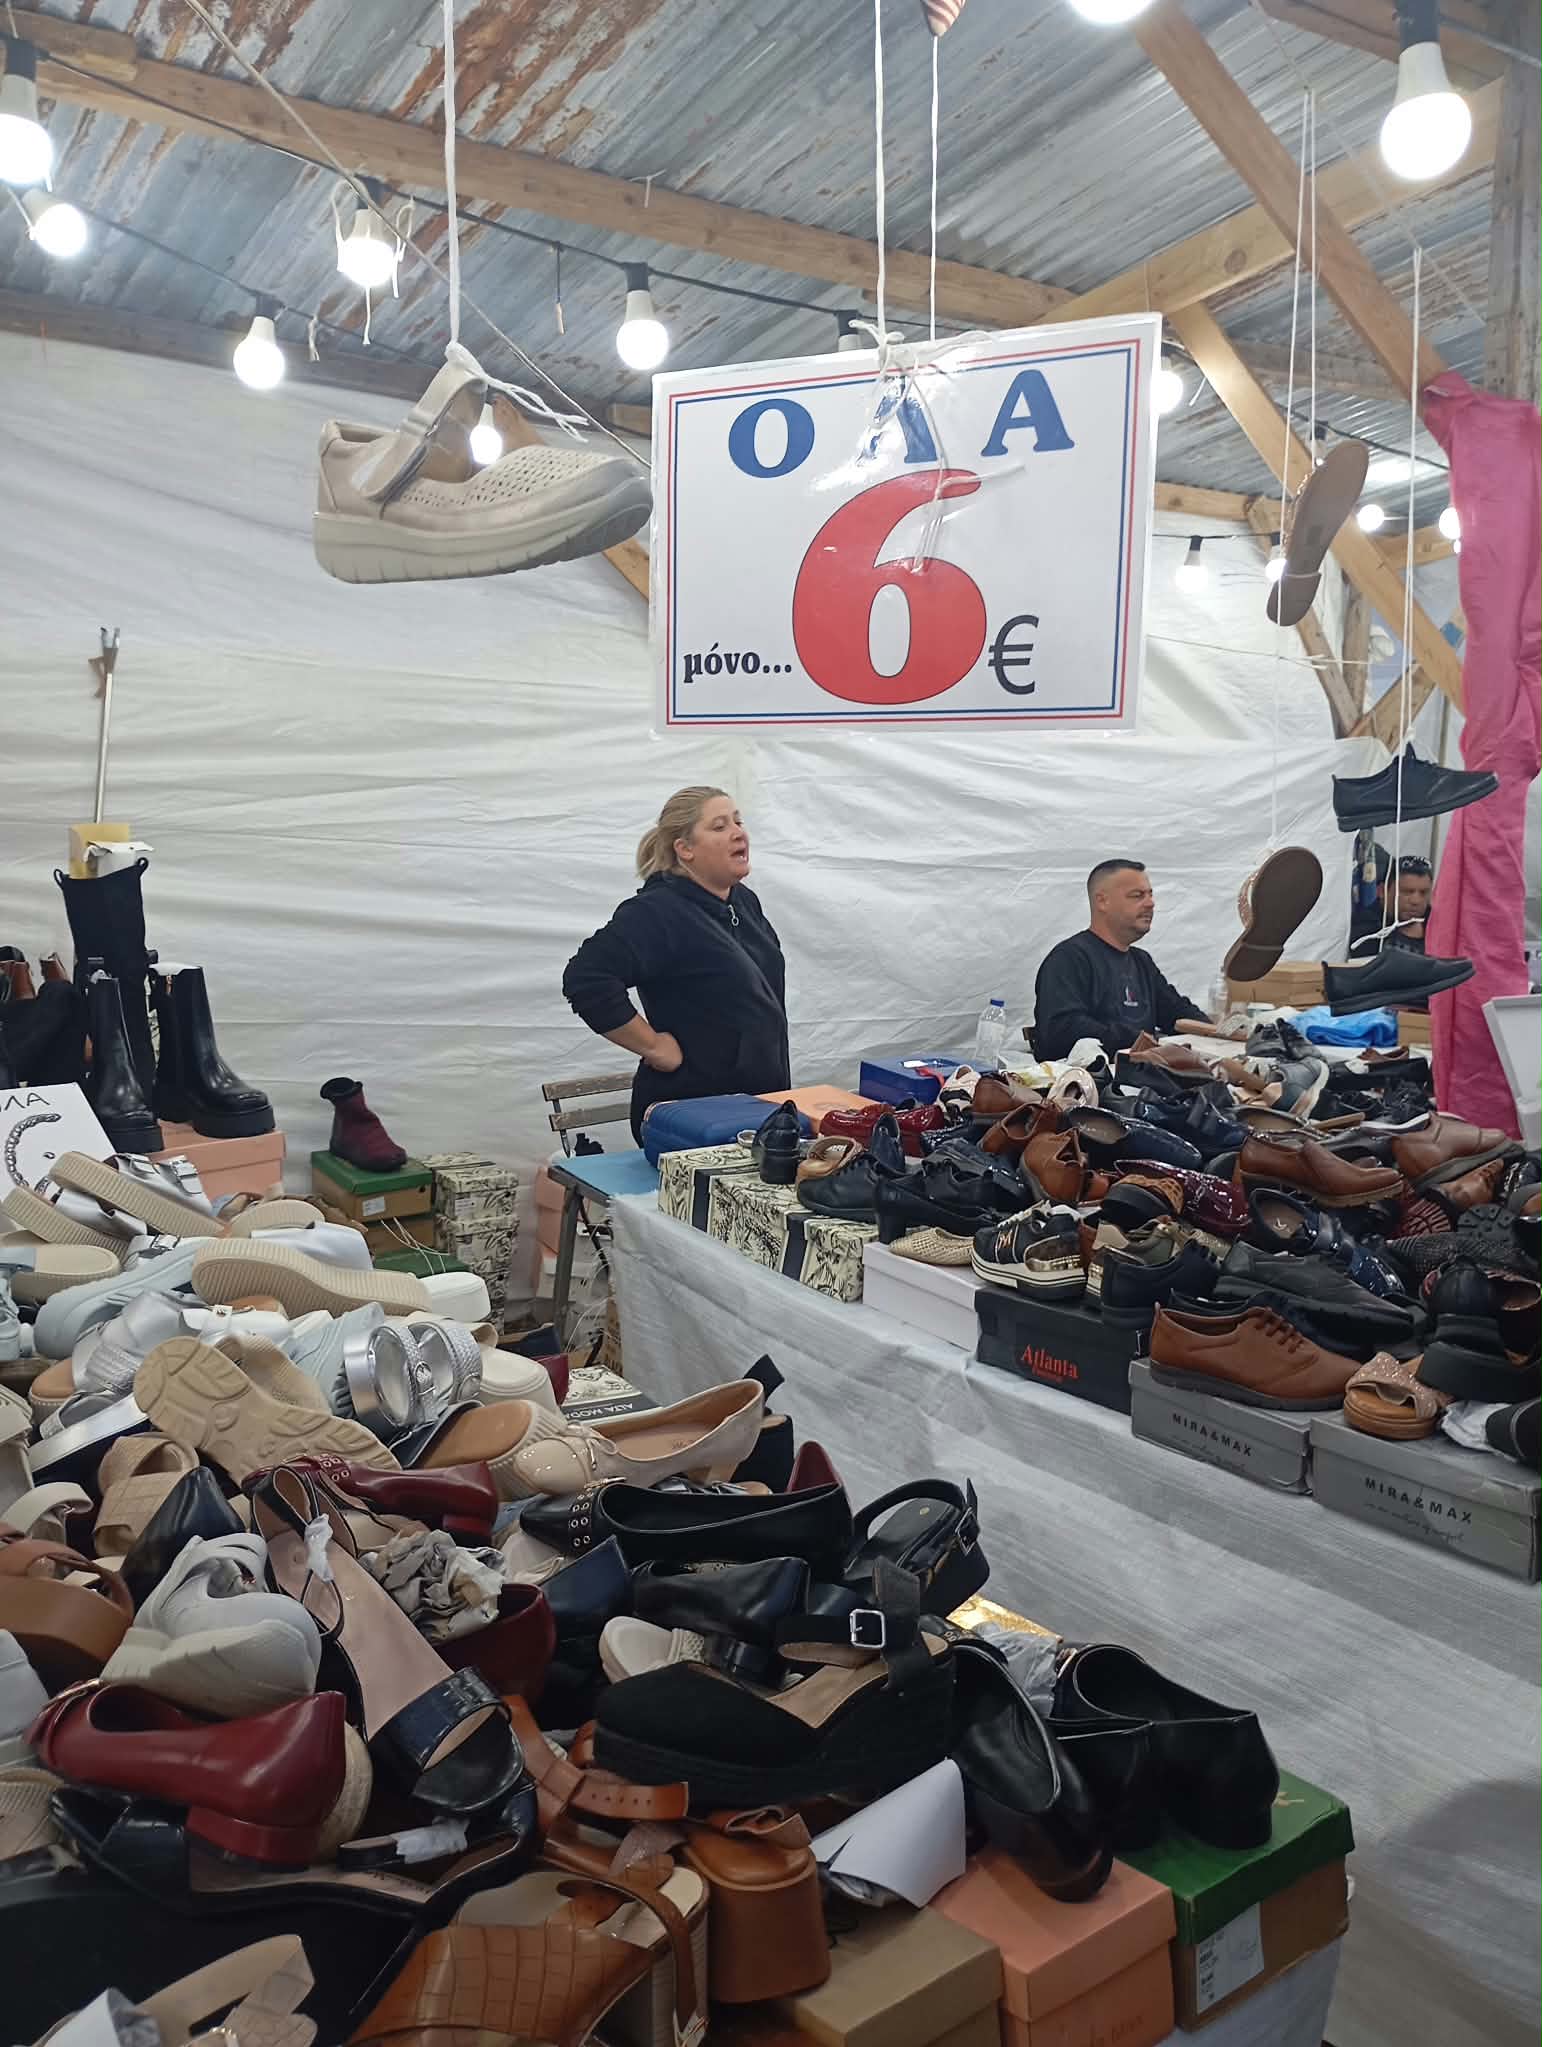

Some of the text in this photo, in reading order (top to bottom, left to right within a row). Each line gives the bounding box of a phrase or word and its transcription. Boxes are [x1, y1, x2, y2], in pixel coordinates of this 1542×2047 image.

[683, 643, 792, 684] μόνο...
[0, 1092, 51, 1113] ΛΑ
[1020, 1344, 1079, 1380] Atlanta
[1172, 1413, 1252, 1457] MIRA&MAX
[1365, 1477, 1472, 1524] MIRA&MAX
